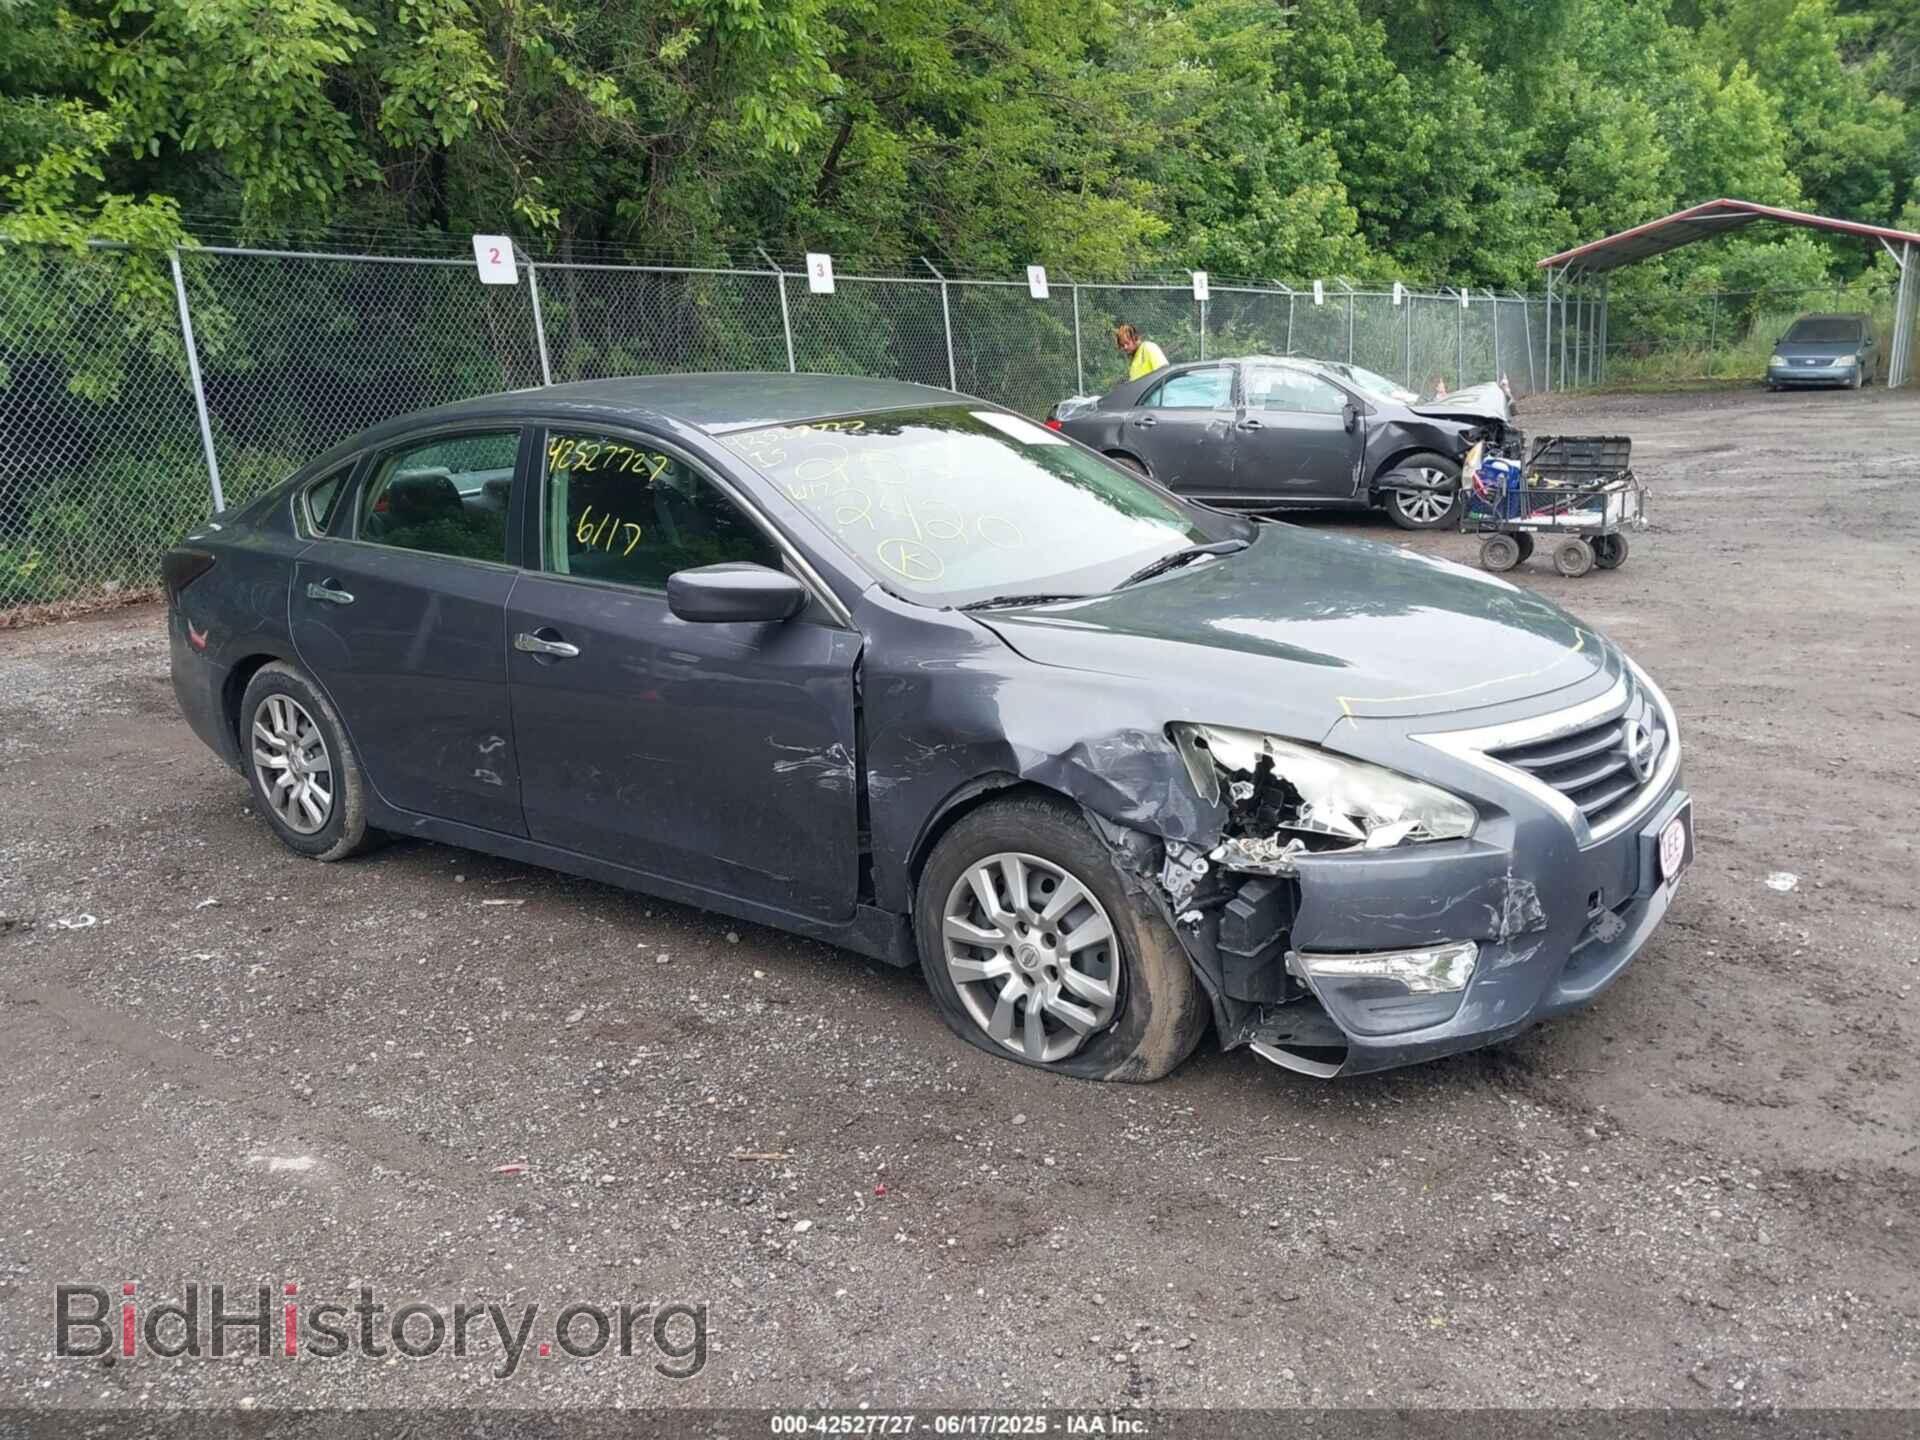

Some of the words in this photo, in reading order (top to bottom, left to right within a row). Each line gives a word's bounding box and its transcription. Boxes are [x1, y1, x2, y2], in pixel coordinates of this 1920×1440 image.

[489, 247, 502, 264] 2
[816, 263, 825, 278] 3
[548, 437, 667, 482] 42527727
